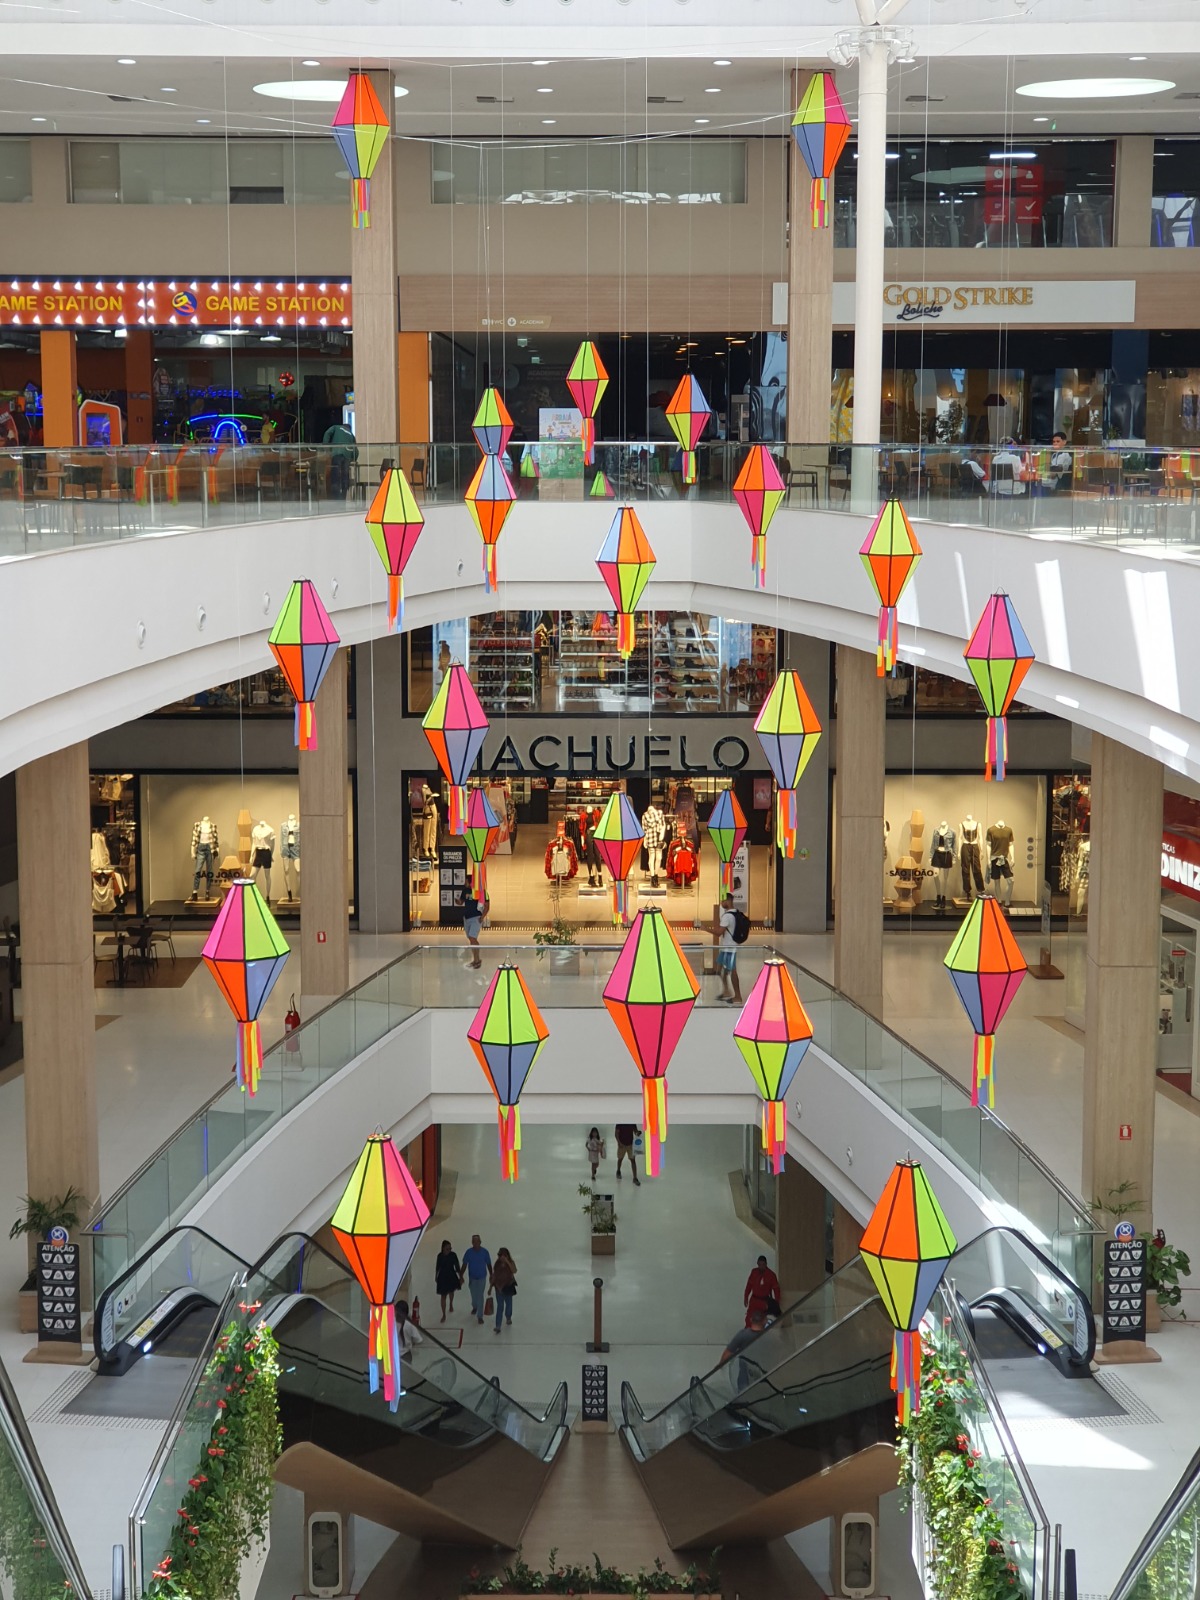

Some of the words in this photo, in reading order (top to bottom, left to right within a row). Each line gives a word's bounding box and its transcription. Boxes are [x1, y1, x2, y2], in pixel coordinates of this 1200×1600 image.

[43, 295, 123, 311] STATION
[206, 296, 260, 311] GAME
[266, 297, 345, 312] STATION
[883, 284, 952, 306] GOLD
[953, 287, 1034, 310] STRIKE
[476, 735, 750, 771] IACHUELO
[42, 1244, 75, 1253] ATENÇÃO
[1110, 1241, 1143, 1250] ATENÇÃO
